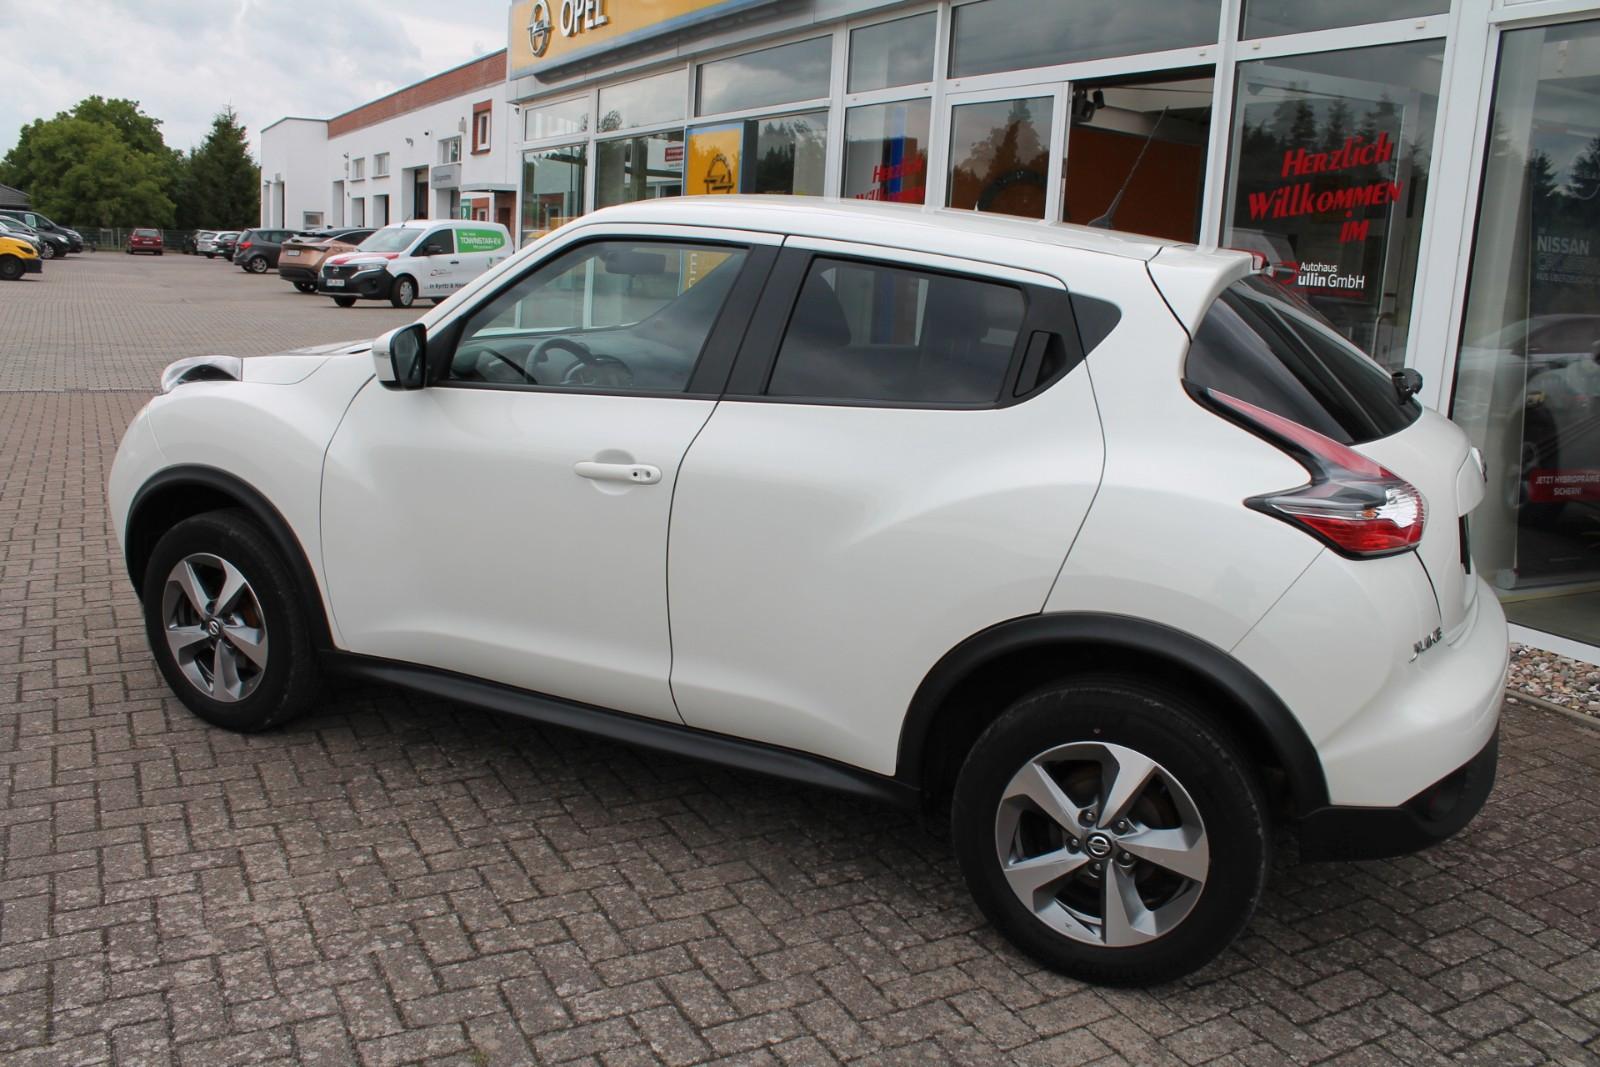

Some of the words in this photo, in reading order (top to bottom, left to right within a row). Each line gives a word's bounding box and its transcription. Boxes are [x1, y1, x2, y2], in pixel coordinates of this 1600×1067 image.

[560, 0, 608, 37] OPEL
[1536, 235, 1590, 257] NISSAN
[1300, 261, 1338, 273] Autohaus
[1327, 273, 1366, 289] GmbH
